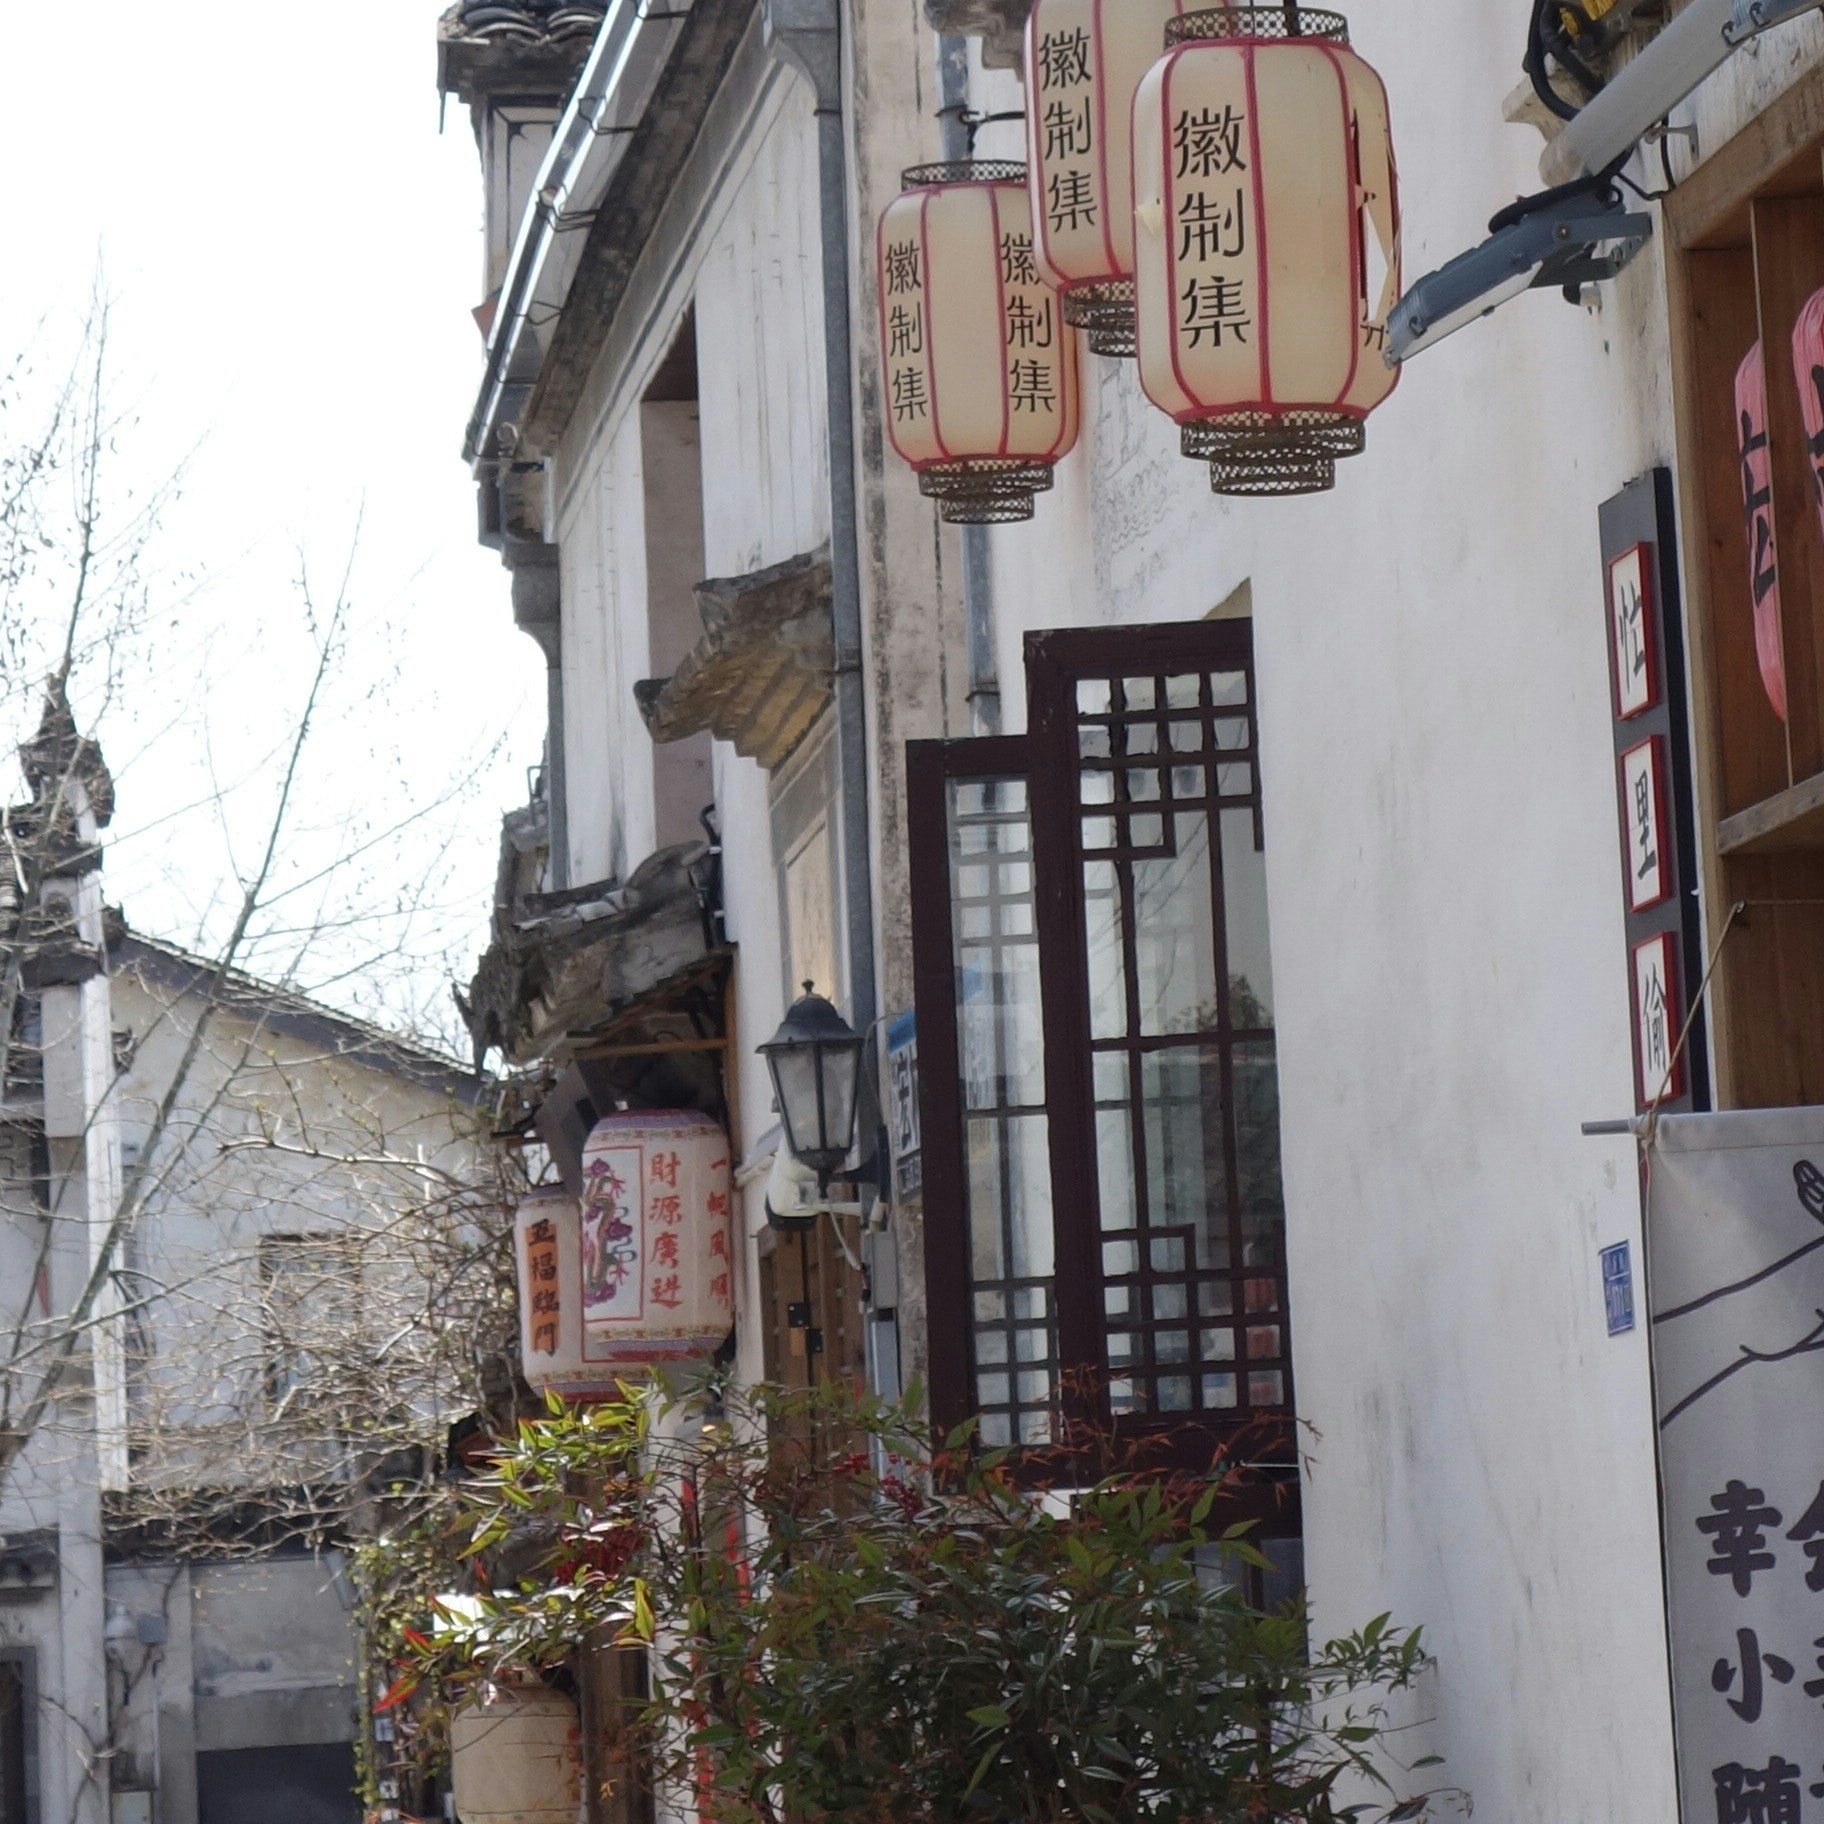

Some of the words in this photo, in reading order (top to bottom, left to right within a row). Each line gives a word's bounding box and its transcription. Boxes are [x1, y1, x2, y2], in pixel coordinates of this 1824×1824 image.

[1039, 26, 1098, 233] 徽制集
[1173, 105, 1251, 349] 徽制集
[885, 238, 929, 422] 徽制集
